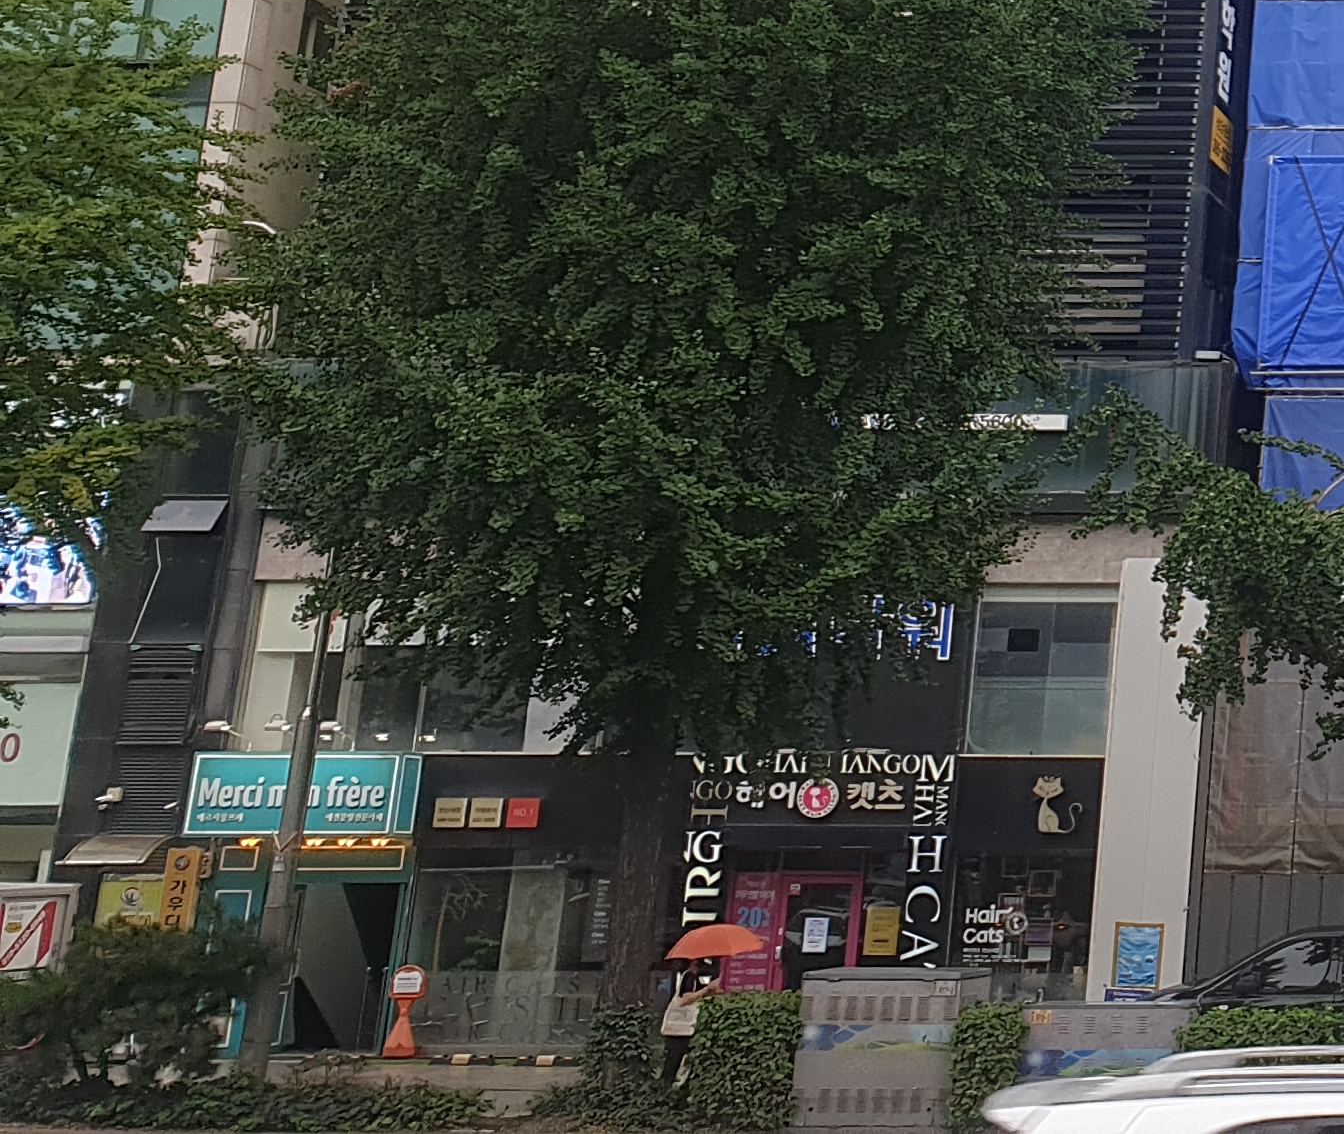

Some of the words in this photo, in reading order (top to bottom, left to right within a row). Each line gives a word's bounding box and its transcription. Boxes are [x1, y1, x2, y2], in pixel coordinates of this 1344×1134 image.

[197, 775, 267, 809] Merci
[266, 783, 321, 808] mn
[326, 775, 386, 809] frère
[846, 778, 906, 810] 캣츠
[964, 904, 1013, 925] Hair
[962, 927, 1004, 945] Cats
